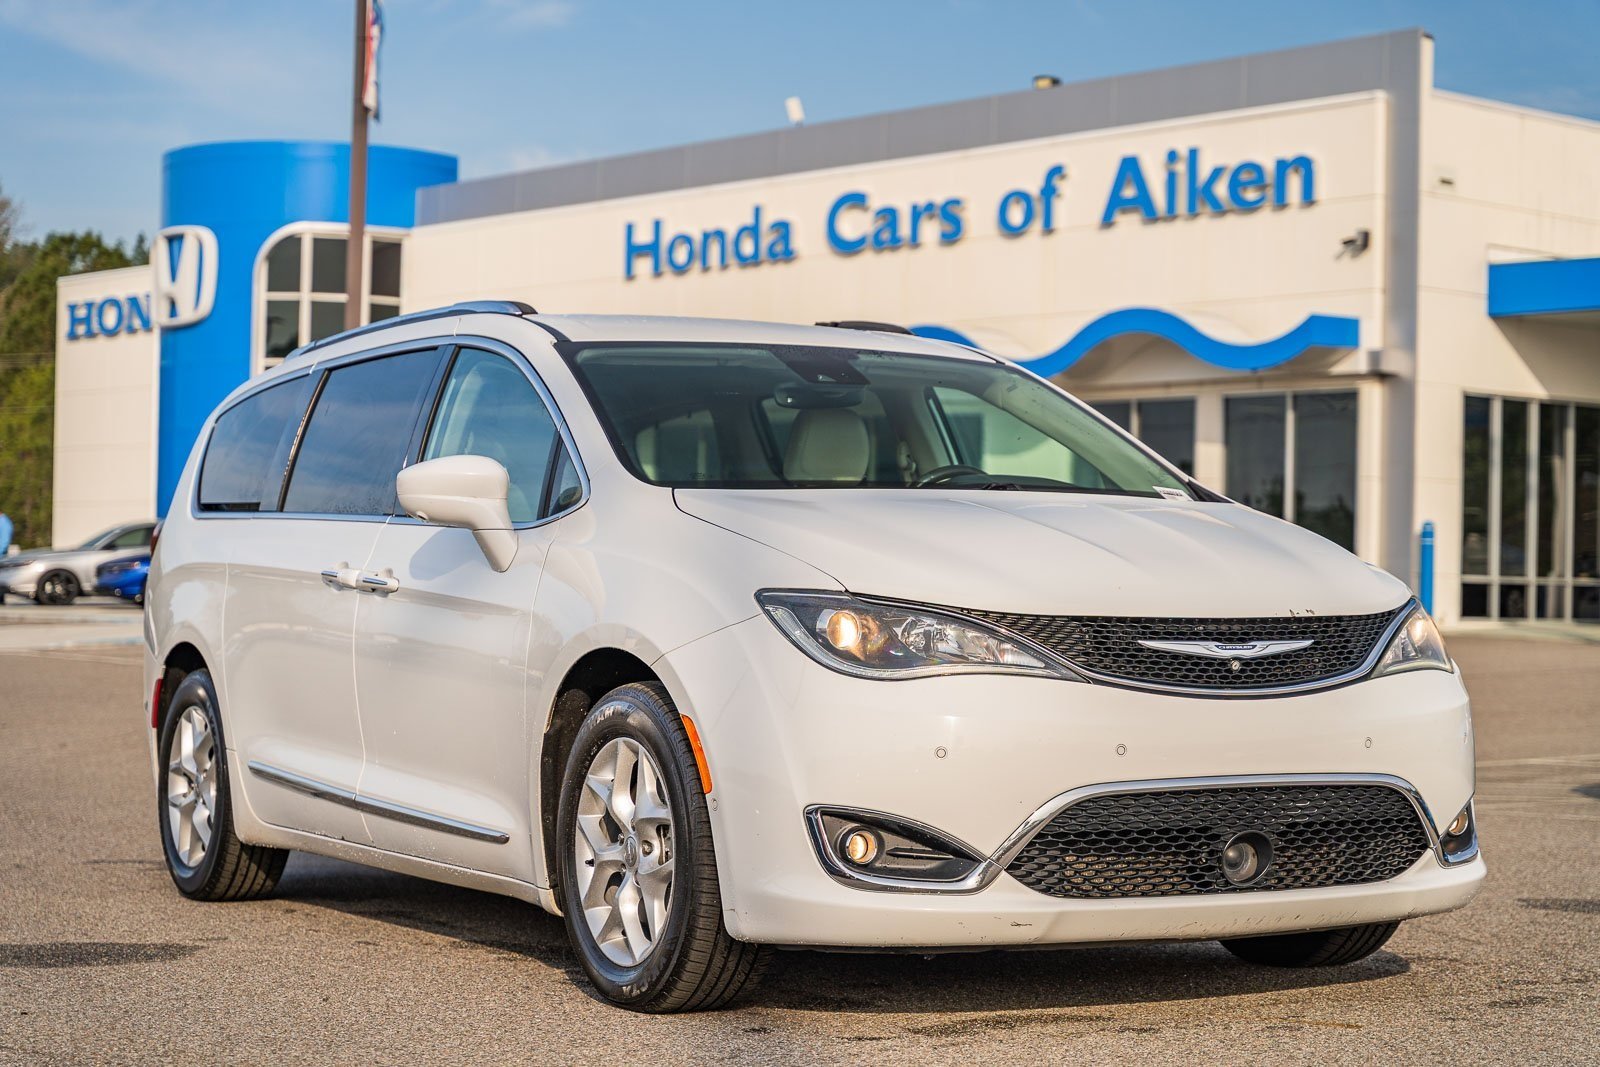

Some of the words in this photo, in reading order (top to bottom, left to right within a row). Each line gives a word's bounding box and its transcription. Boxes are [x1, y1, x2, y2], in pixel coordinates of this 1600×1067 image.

[624, 206, 795, 279] Honda
[827, 191, 964, 254] Cars
[998, 164, 1066, 235] of
[1101, 147, 1316, 226] Aiken
